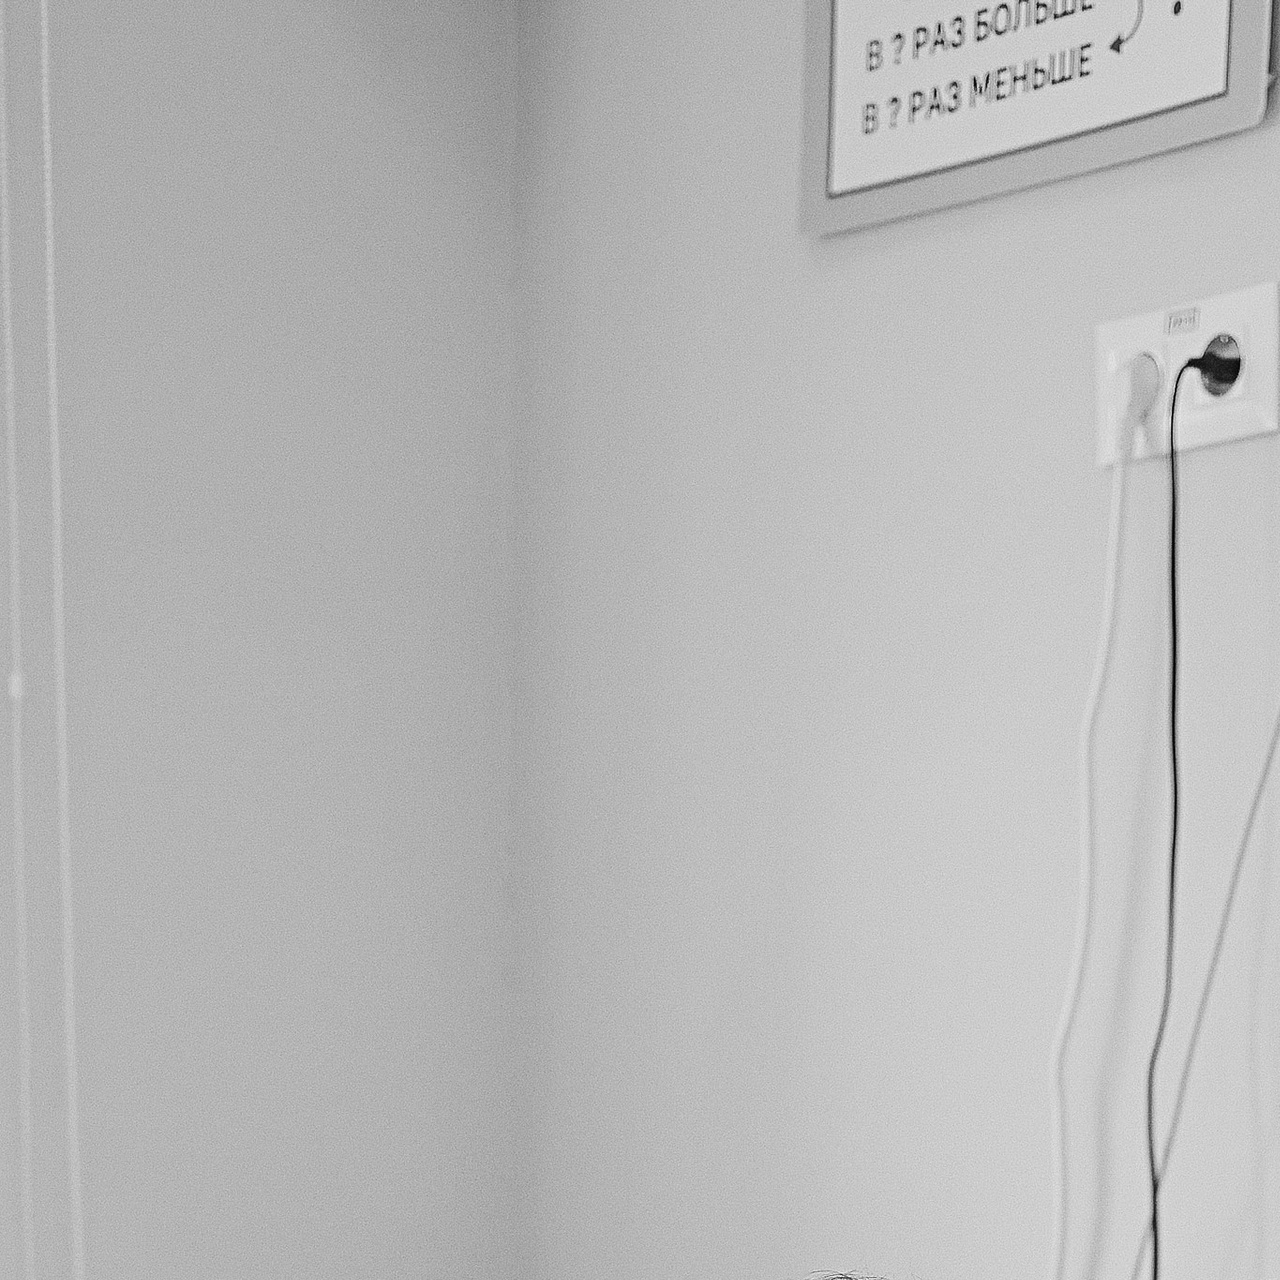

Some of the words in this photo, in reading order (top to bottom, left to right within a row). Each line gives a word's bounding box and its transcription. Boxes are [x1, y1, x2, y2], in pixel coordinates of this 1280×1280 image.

[866, 40, 883, 71] В
[912, 16, 965, 59] РАЗ
[862, 103, 879, 134] В
[907, 81, 961, 123] РАЗ
[969, 43, 1093, 107] МЕНЬШЕ
